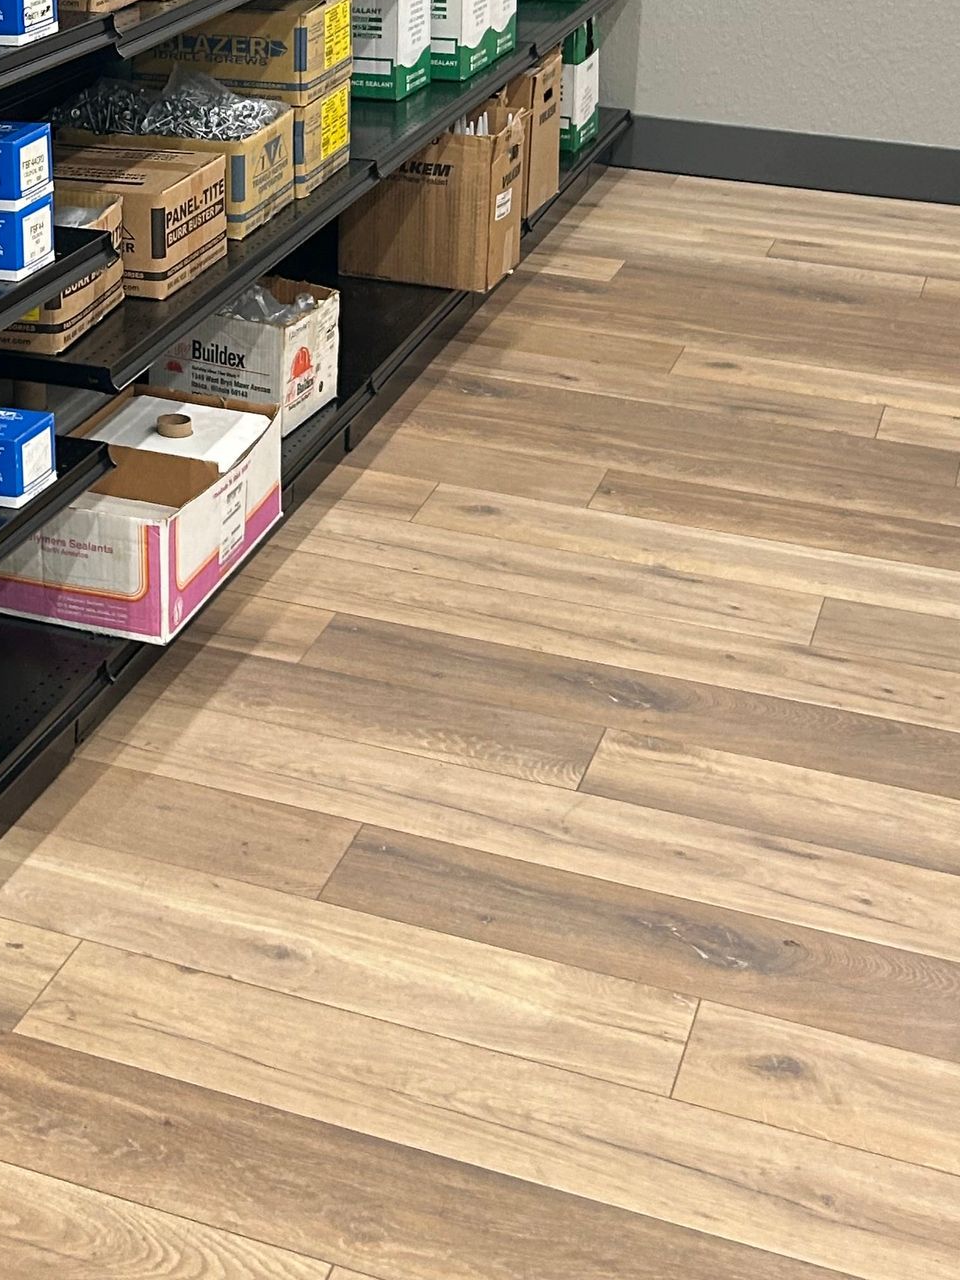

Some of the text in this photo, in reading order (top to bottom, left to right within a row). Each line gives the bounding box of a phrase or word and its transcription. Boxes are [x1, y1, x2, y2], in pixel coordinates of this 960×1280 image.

[167, 179, 223, 228] PANEL-TITE
[168, 209, 215, 243] BURR BUSTER
[192, 340, 246, 369] Buildex
[69, 539, 113, 554] Sealants
